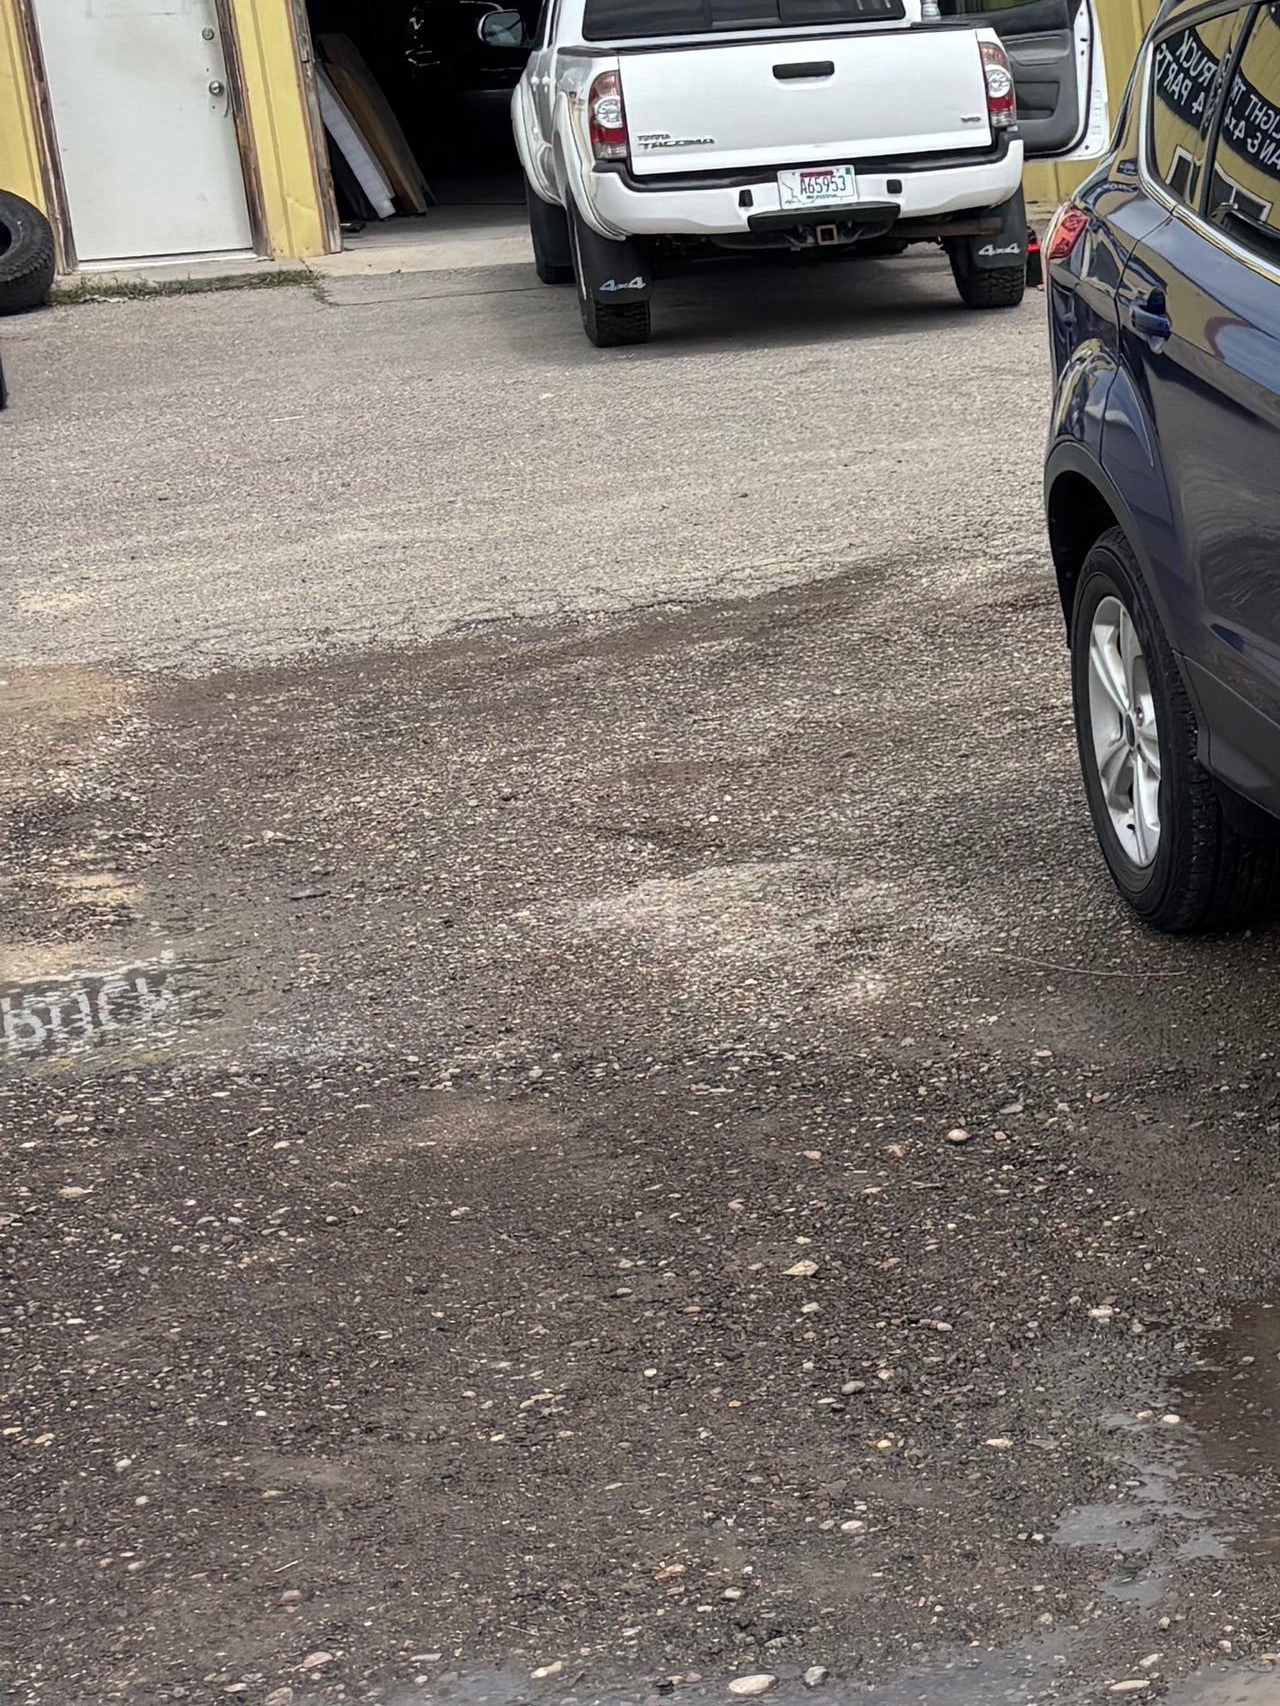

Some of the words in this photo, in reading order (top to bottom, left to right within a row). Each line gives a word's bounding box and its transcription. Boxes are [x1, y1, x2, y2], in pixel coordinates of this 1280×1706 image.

[800, 175, 847, 195] A65953
[978, 243, 1020, 256] 4x4
[599, 276, 646, 292] 4x4
